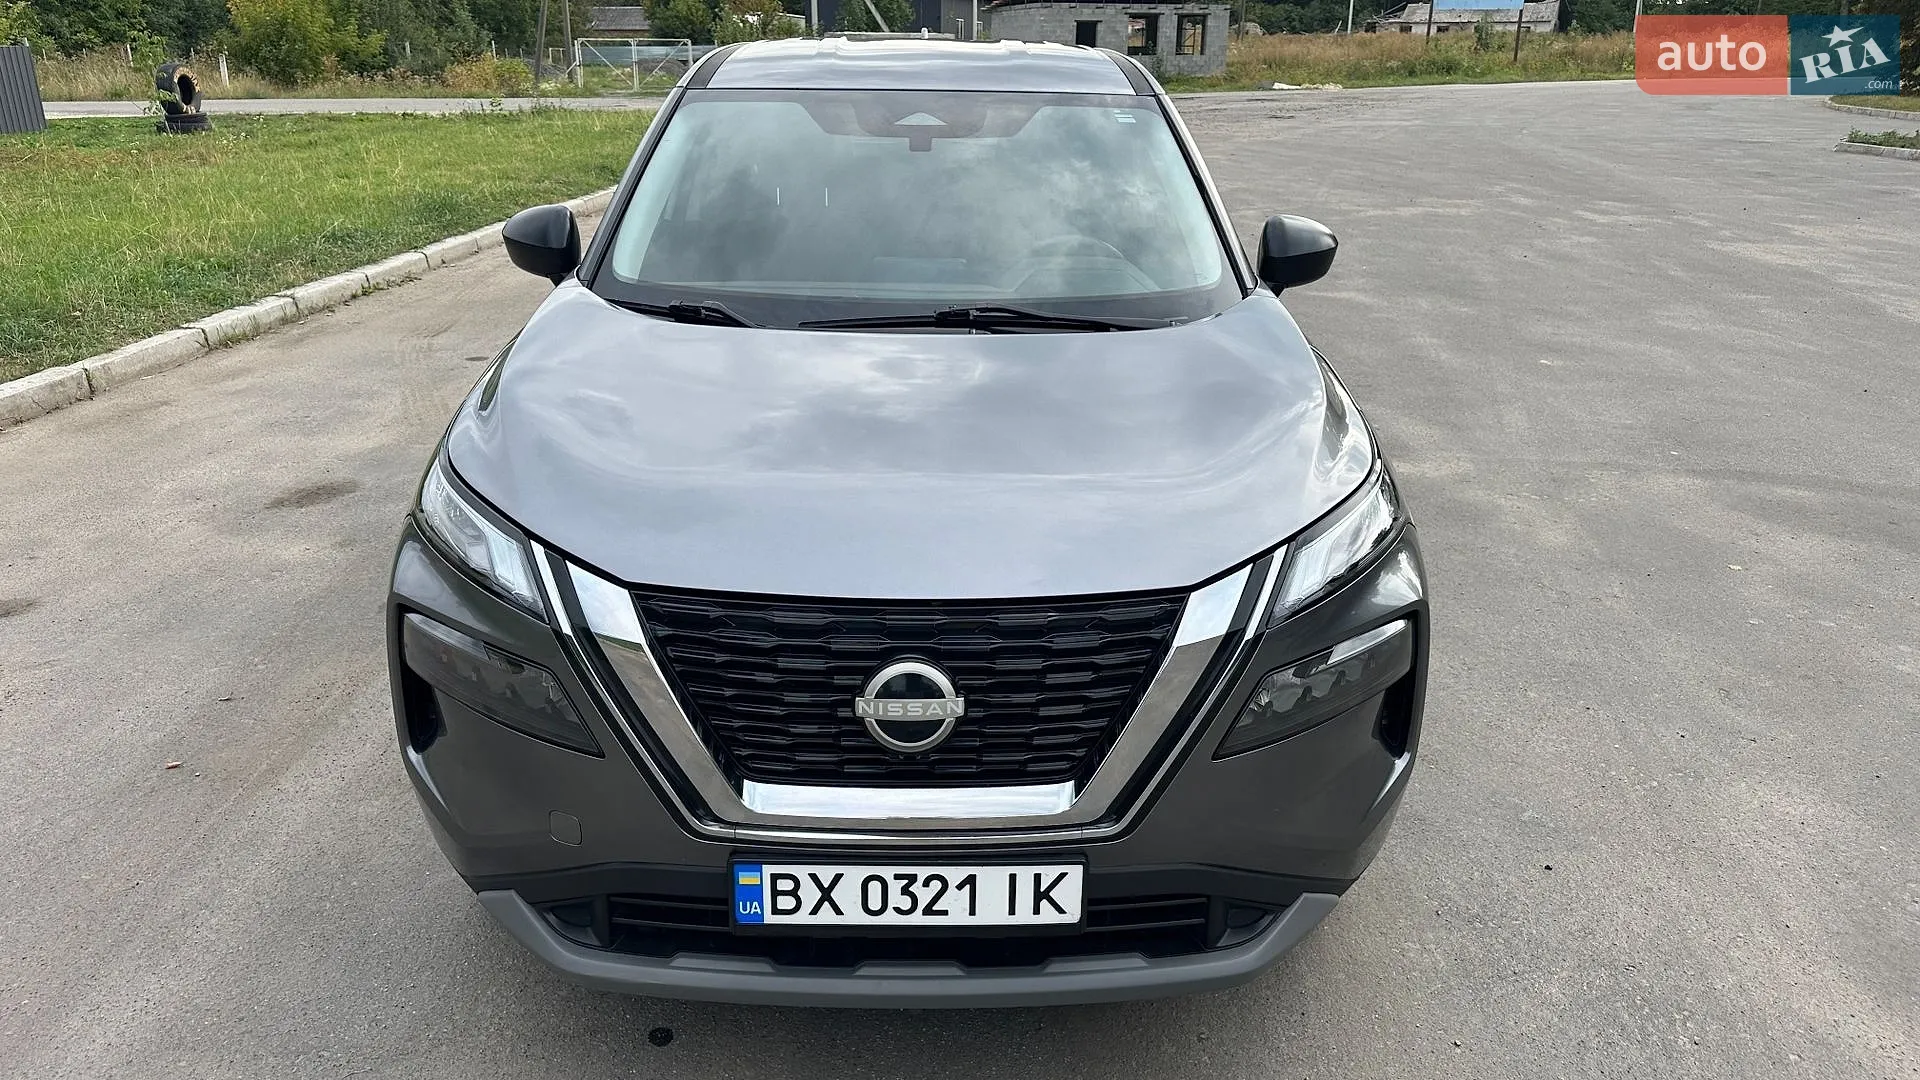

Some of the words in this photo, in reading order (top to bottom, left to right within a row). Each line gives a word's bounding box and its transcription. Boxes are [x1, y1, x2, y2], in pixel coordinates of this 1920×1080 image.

[858, 700, 964, 717] NISSAN
[769, 872, 845, 917] BX
[860, 873, 977, 917] 0321
[1007, 872, 1069, 917] IK
[739, 901, 762, 915] UA
